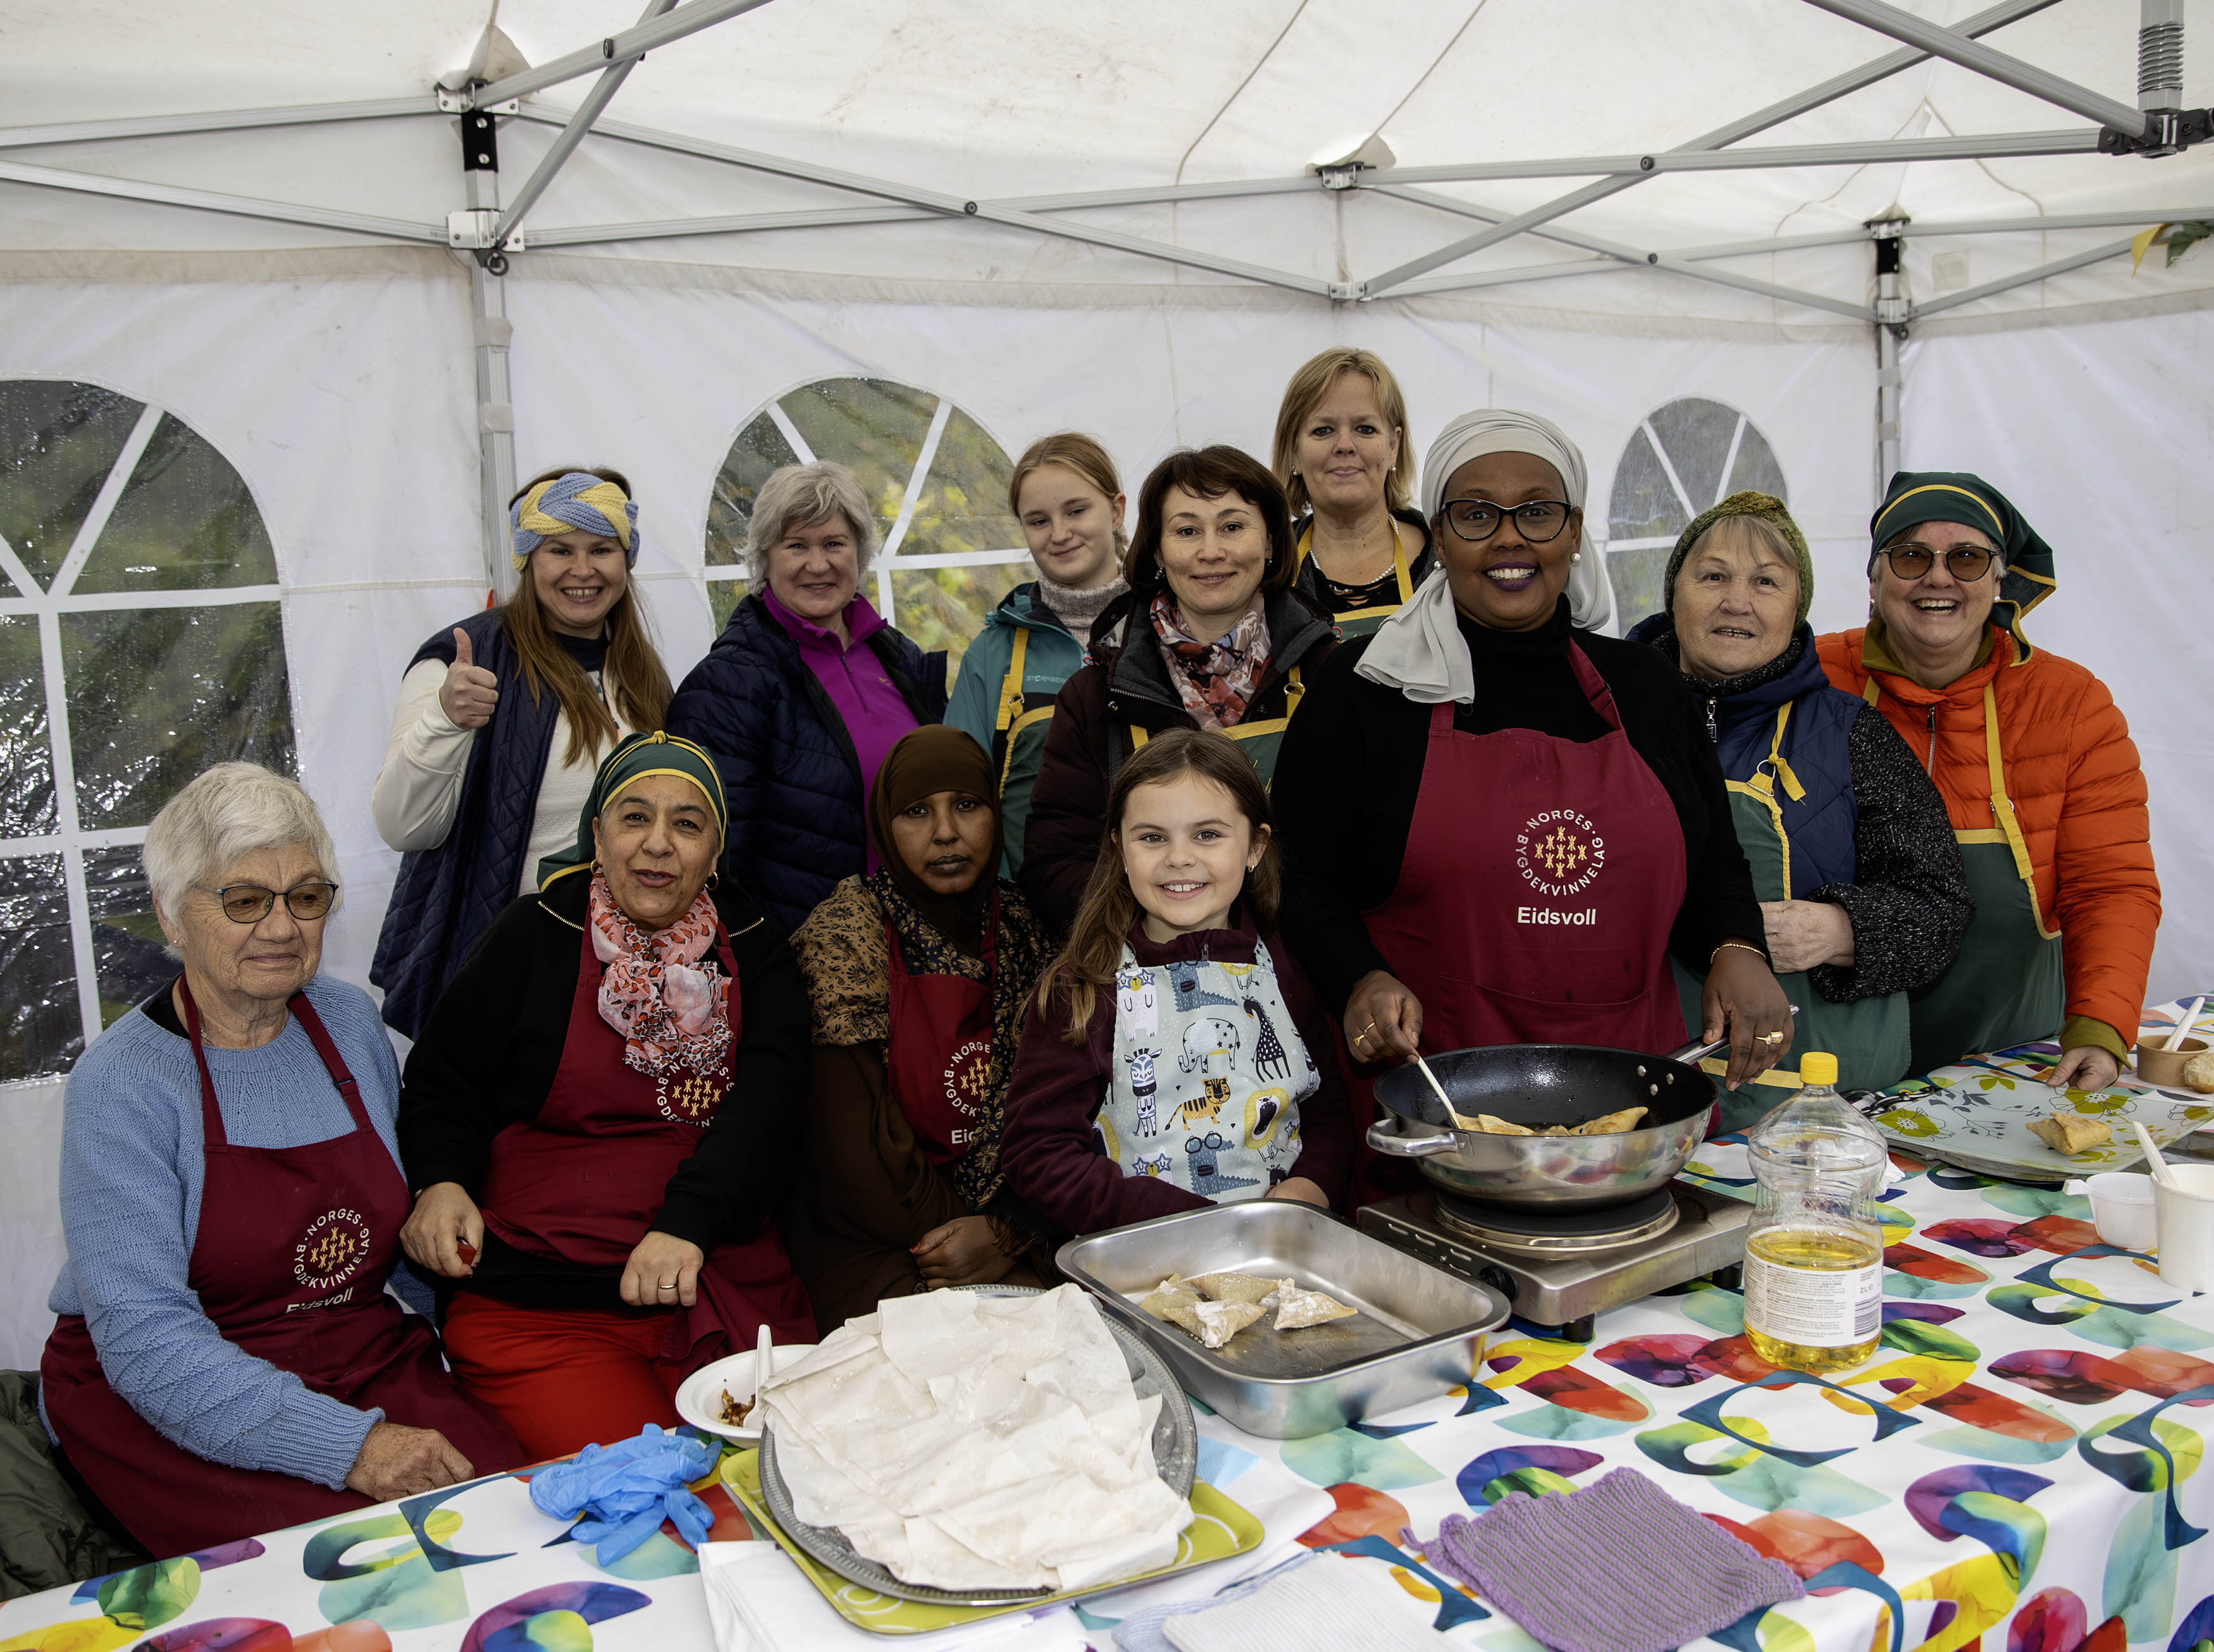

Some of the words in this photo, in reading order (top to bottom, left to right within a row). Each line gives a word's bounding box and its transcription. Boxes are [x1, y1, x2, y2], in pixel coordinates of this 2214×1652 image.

[1526, 809, 1593, 830] NORGES
[1516, 834, 1605, 896] BYGDEKVINNELAG
[1518, 906, 1597, 925] Eidsvoll
[951, 1041, 991, 1064] NORGE
[307, 1209, 361, 1236] NORGES
[294, 1228, 369, 1289] BYGDEKVINNELAG
